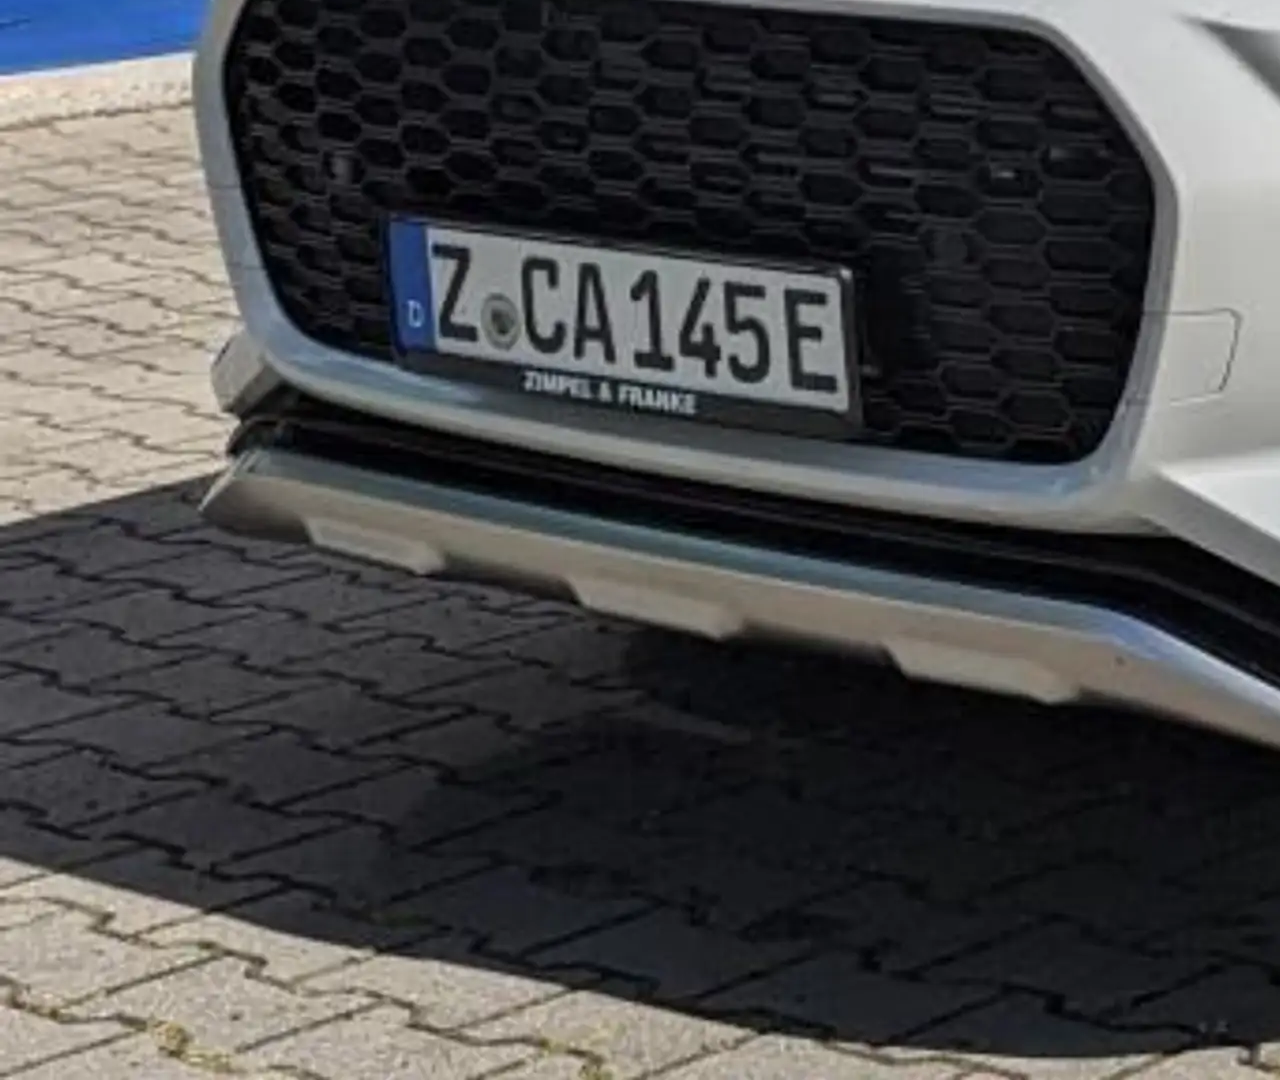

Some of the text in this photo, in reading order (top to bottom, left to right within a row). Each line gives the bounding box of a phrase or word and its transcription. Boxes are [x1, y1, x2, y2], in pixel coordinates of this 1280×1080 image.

[431, 242, 478, 343] Z
[523, 370, 595, 403] ZIMPEL
[617, 382, 699, 415] FRANKE
